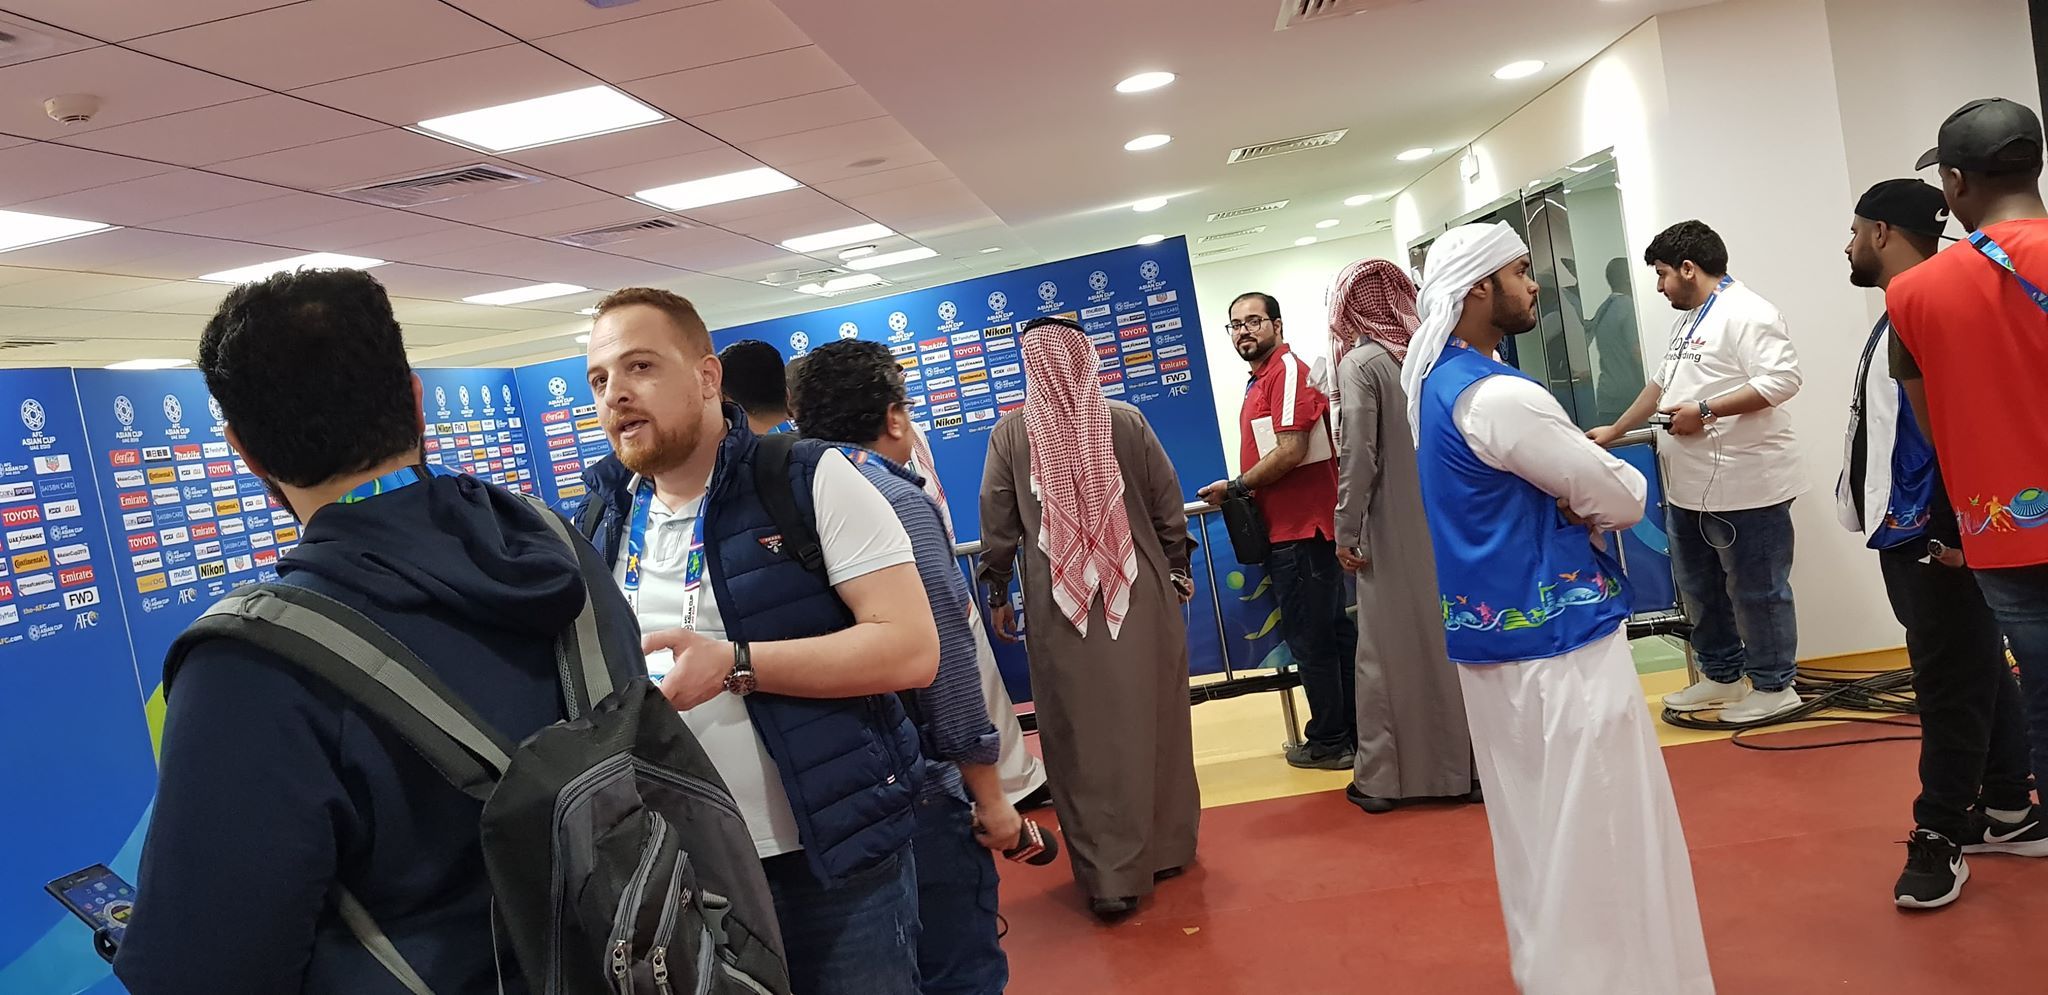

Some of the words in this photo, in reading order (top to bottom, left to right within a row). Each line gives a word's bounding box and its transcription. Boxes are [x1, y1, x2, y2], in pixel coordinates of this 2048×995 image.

[986, 327, 1012, 337] Nikon
[1120, 328, 1148, 336] TOYOTA
[954, 346, 982, 356] TOYOTA
[1160, 360, 1188, 370] Emirates
[1100, 372, 1122, 381] OYOTA
[1166, 373, 1186, 383] FWD
[930, 392, 957, 402] Emirates
[936, 417, 962, 428] Nikon
[22, 438, 42, 446] ASIAN
[42, 436, 56, 444] CUP
[549, 438, 574, 447] Emirates
[208, 464, 232, 474] TOYOTA
[554, 462, 580, 472] TOYOTA
[120, 496, 148, 506] Emirates
[3, 510, 40, 522] TOYOTA
[192, 527, 216, 537] Emirates
[128, 536, 158, 548] TOYOTA
[200, 564, 224, 578] Nikon
[60, 570, 94, 584] Emirates
[69, 590, 94, 606] FWD
[178, 588, 198, 606] AFC
[74, 610, 98, 631] AFC
